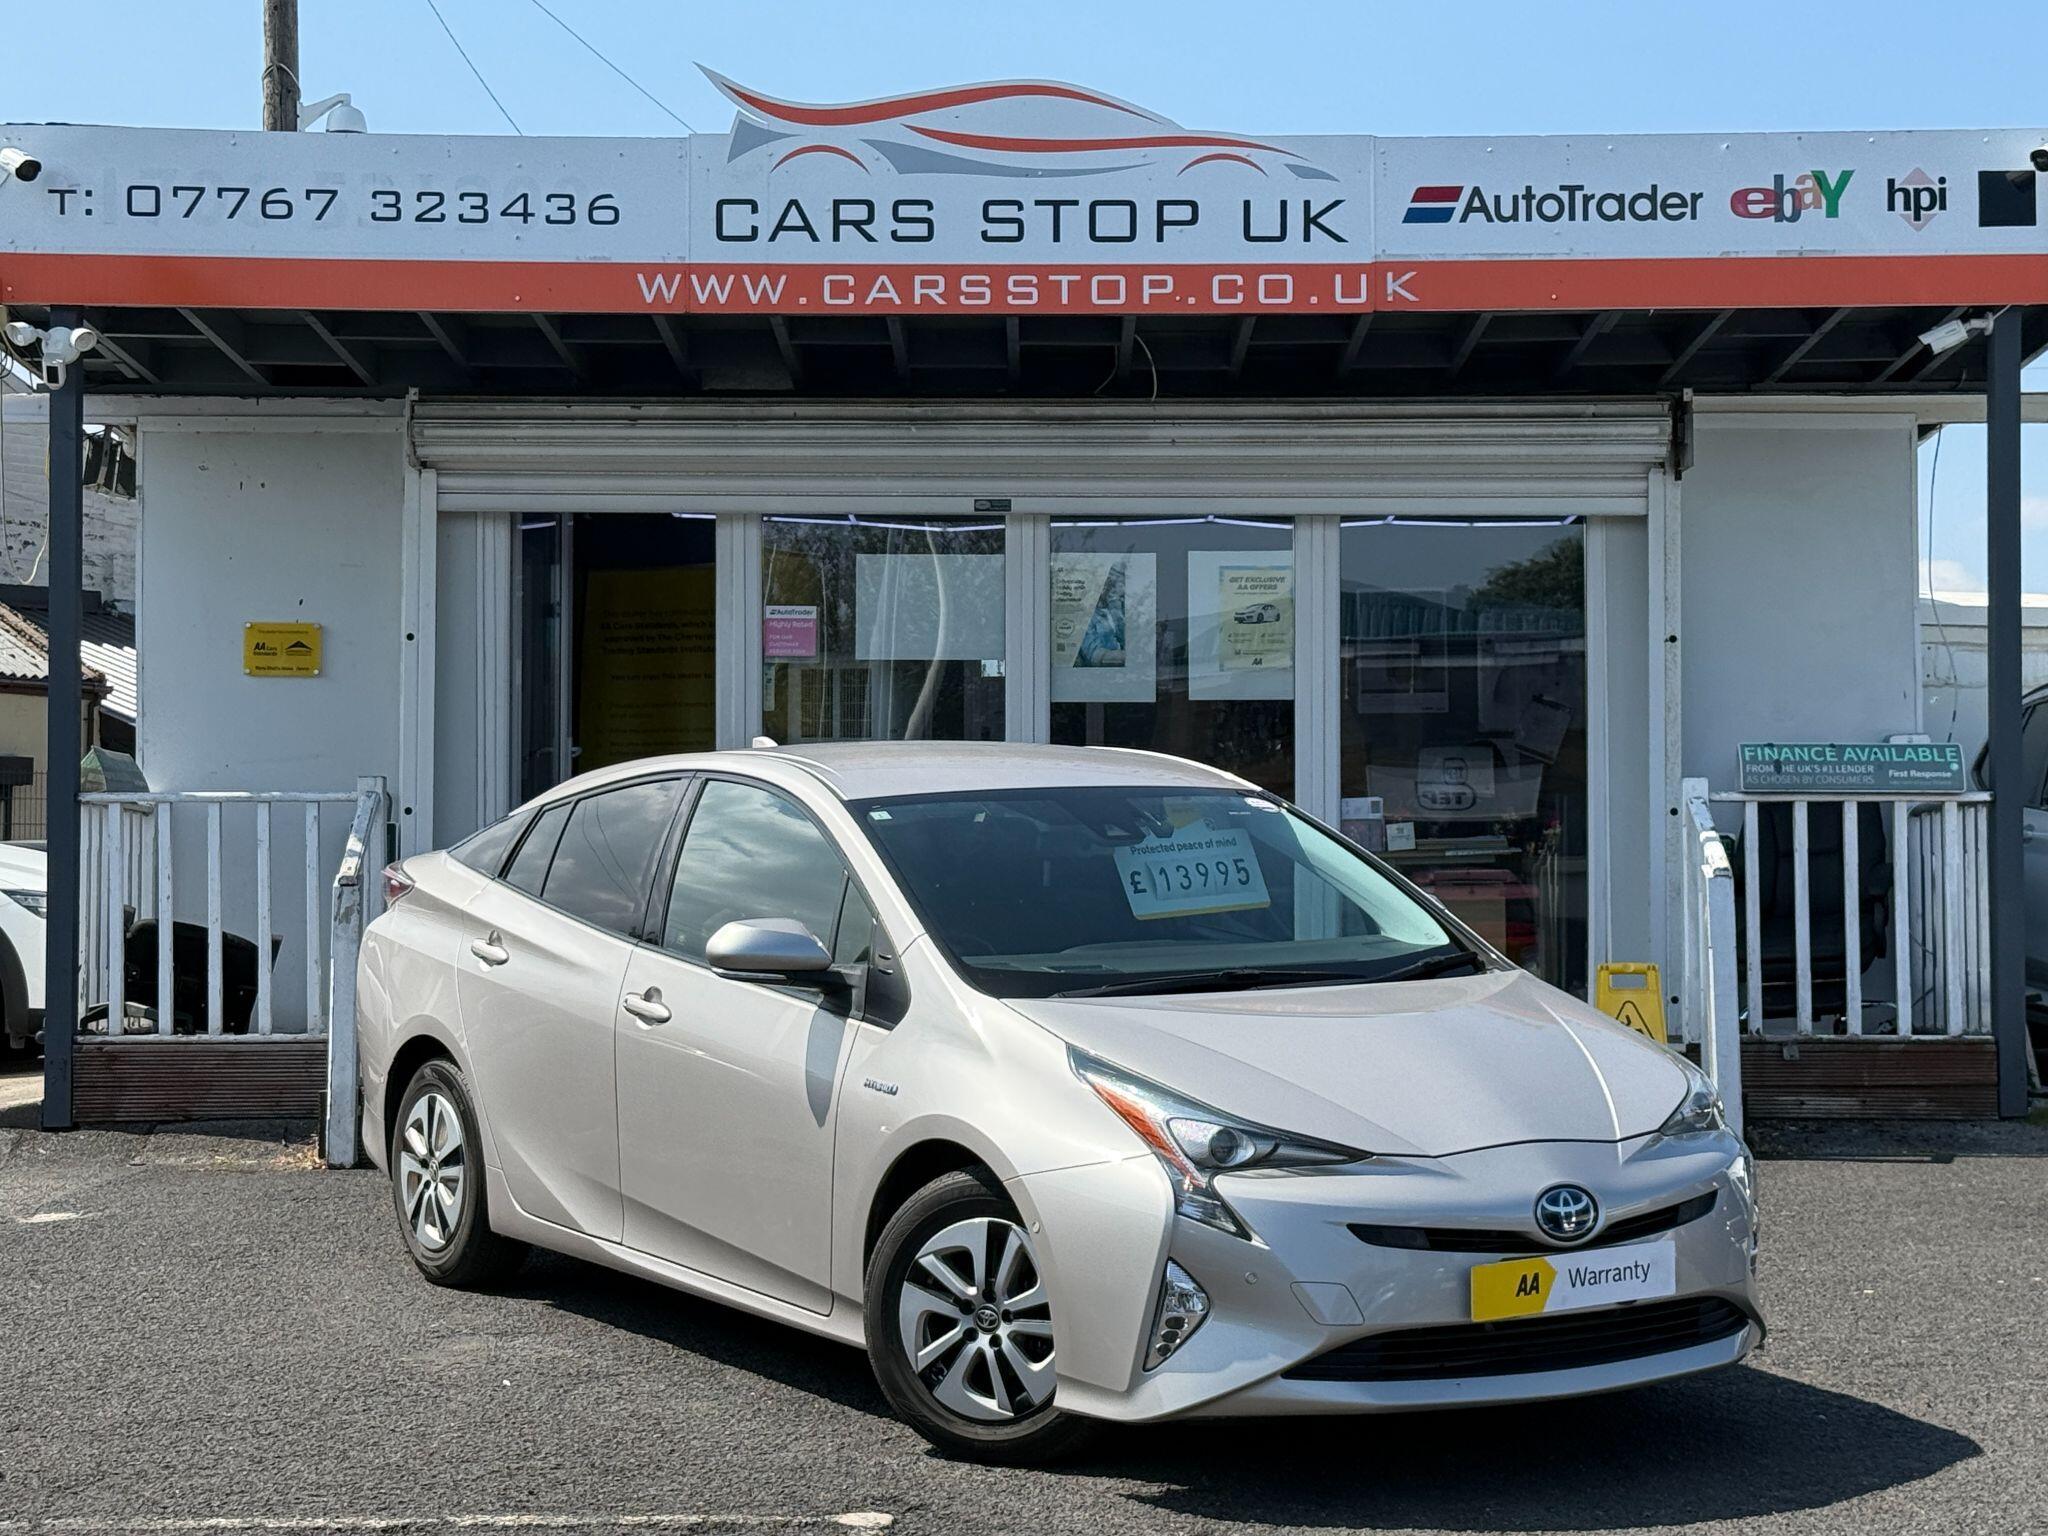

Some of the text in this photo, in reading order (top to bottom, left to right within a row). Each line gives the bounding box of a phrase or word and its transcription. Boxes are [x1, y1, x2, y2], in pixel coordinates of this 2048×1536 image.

[47, 185, 621, 226] T: 07767 323436
[1458, 183, 1704, 223] AutoTrader
[1886, 175, 1948, 222] hpi
[715, 198, 1348, 243] CARS STOP UK
[1744, 746, 1958, 762] FINANCE AVAILABLE
[1746, 764, 1774, 773] FROM
[1836, 764, 1874, 774] LENDER
[1888, 769, 1952, 779] First Response
[1130, 837, 1238, 856] Protected peace of mind
[1515, 1260, 1651, 1298] AA Warranty
